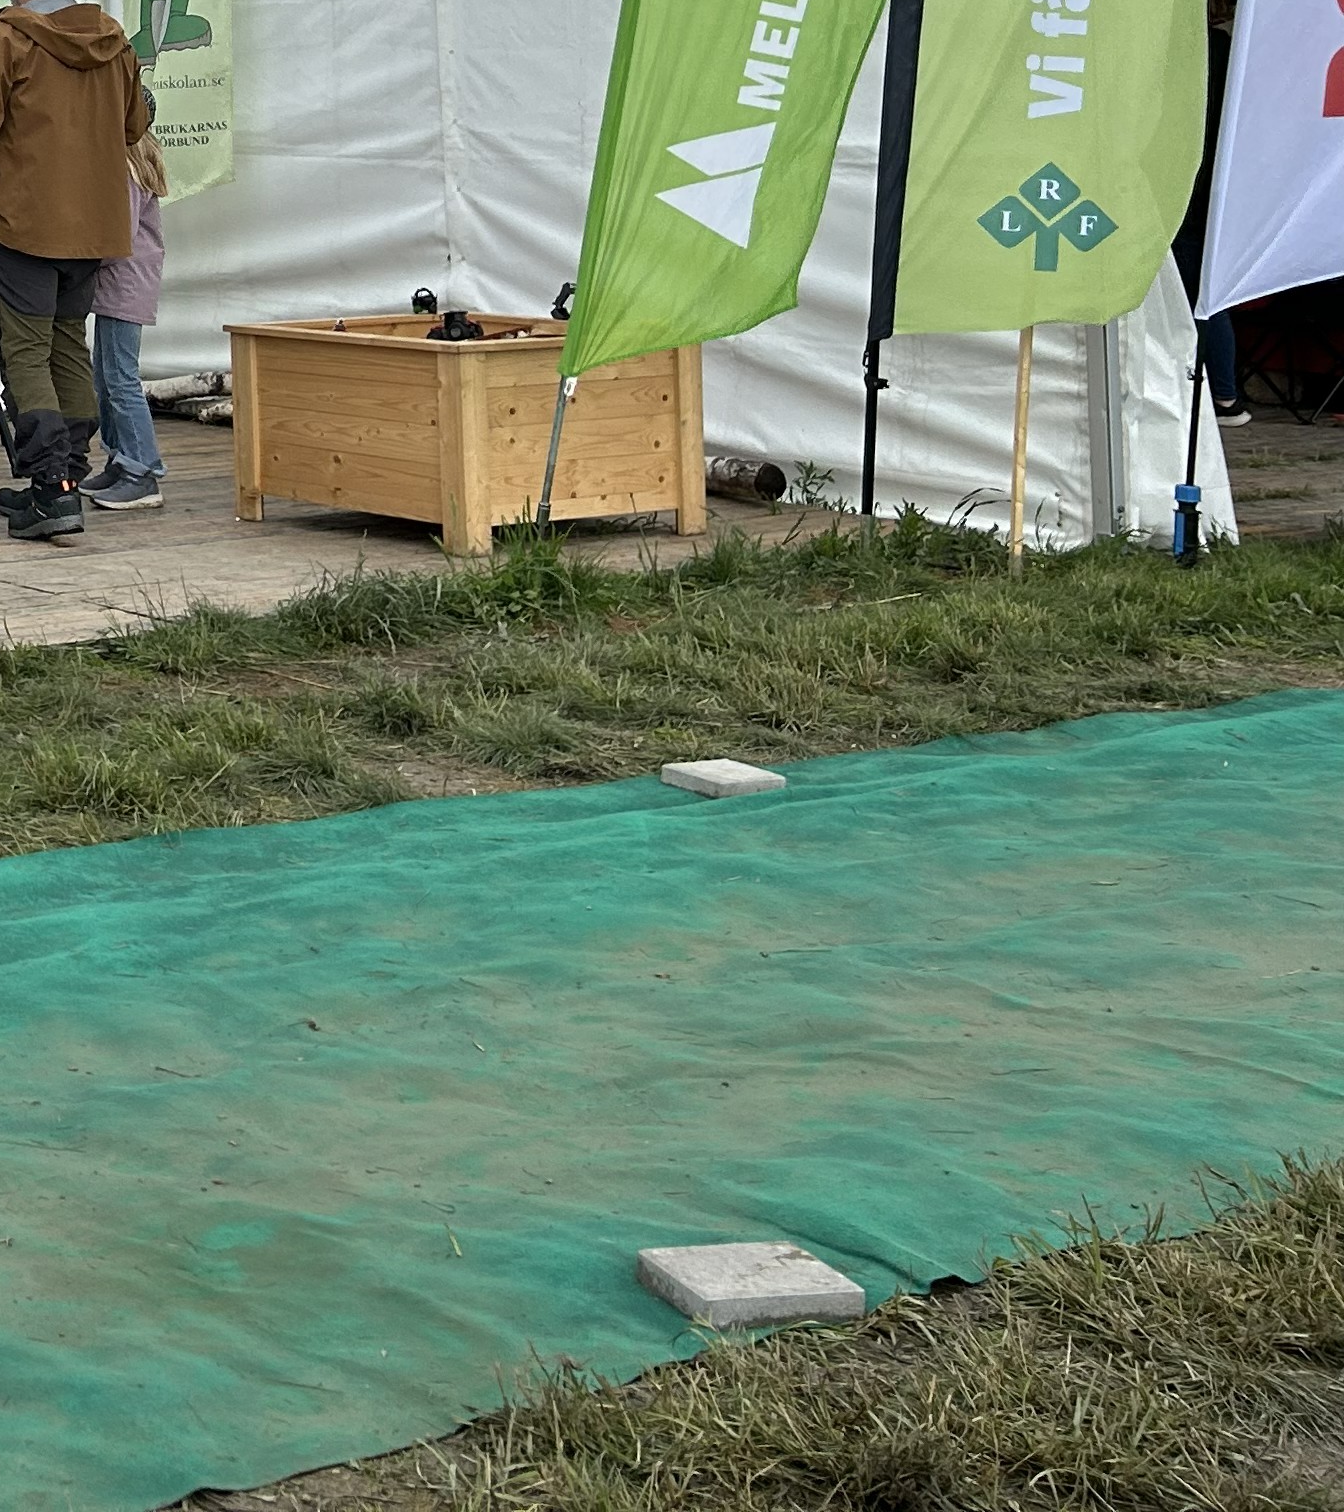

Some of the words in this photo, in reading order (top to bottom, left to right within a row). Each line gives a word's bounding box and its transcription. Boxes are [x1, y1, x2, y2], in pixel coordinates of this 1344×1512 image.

[153, 75, 226, 90] niskolan.se
[1026, 54, 1085, 119] Vi
[152, 121, 228, 134] BRUKARNAS
[160, 135, 210, 148] ÖRBUND
